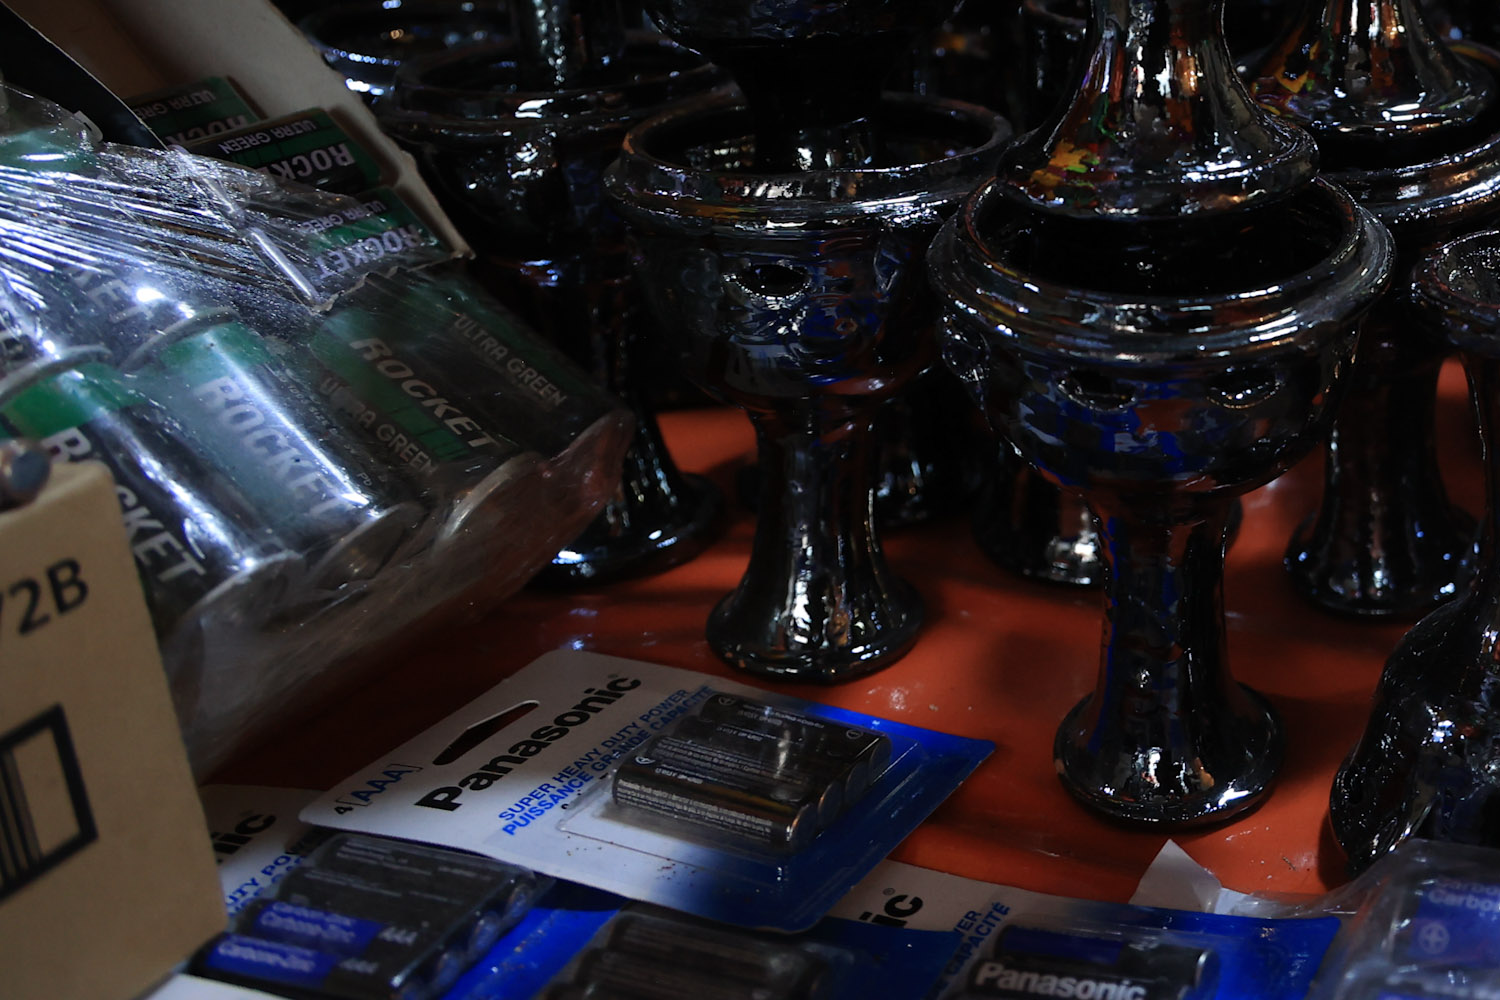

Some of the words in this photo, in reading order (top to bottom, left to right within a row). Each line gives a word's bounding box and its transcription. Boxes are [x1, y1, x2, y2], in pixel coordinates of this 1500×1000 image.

[218, 132, 273, 155] GREEN
[270, 119, 318, 139] ULTRA
[257, 143, 356, 180] ROCK
[315, 223, 423, 280] ROCKET
[454, 313, 509, 361] ULTRA
[505, 358, 568, 408] GREEN
[349, 337, 503, 449] ROCKET
[193, 374, 348, 520] ROCKET
[376, 422, 439, 475] GREEN
[414, 677, 642, 812] Panasonic
[499, 781, 556, 822] SUPER
[552, 748, 602, 784] HEAVY
[601, 721, 641, 752] DUTY
[639, 688, 689, 723] POWER
[335, 801, 353, 816] 4
[502, 773, 595, 836] PUISSANCE
[593, 727, 651, 773] GRANDE
[974, 961, 1148, 1000] Panasonic
